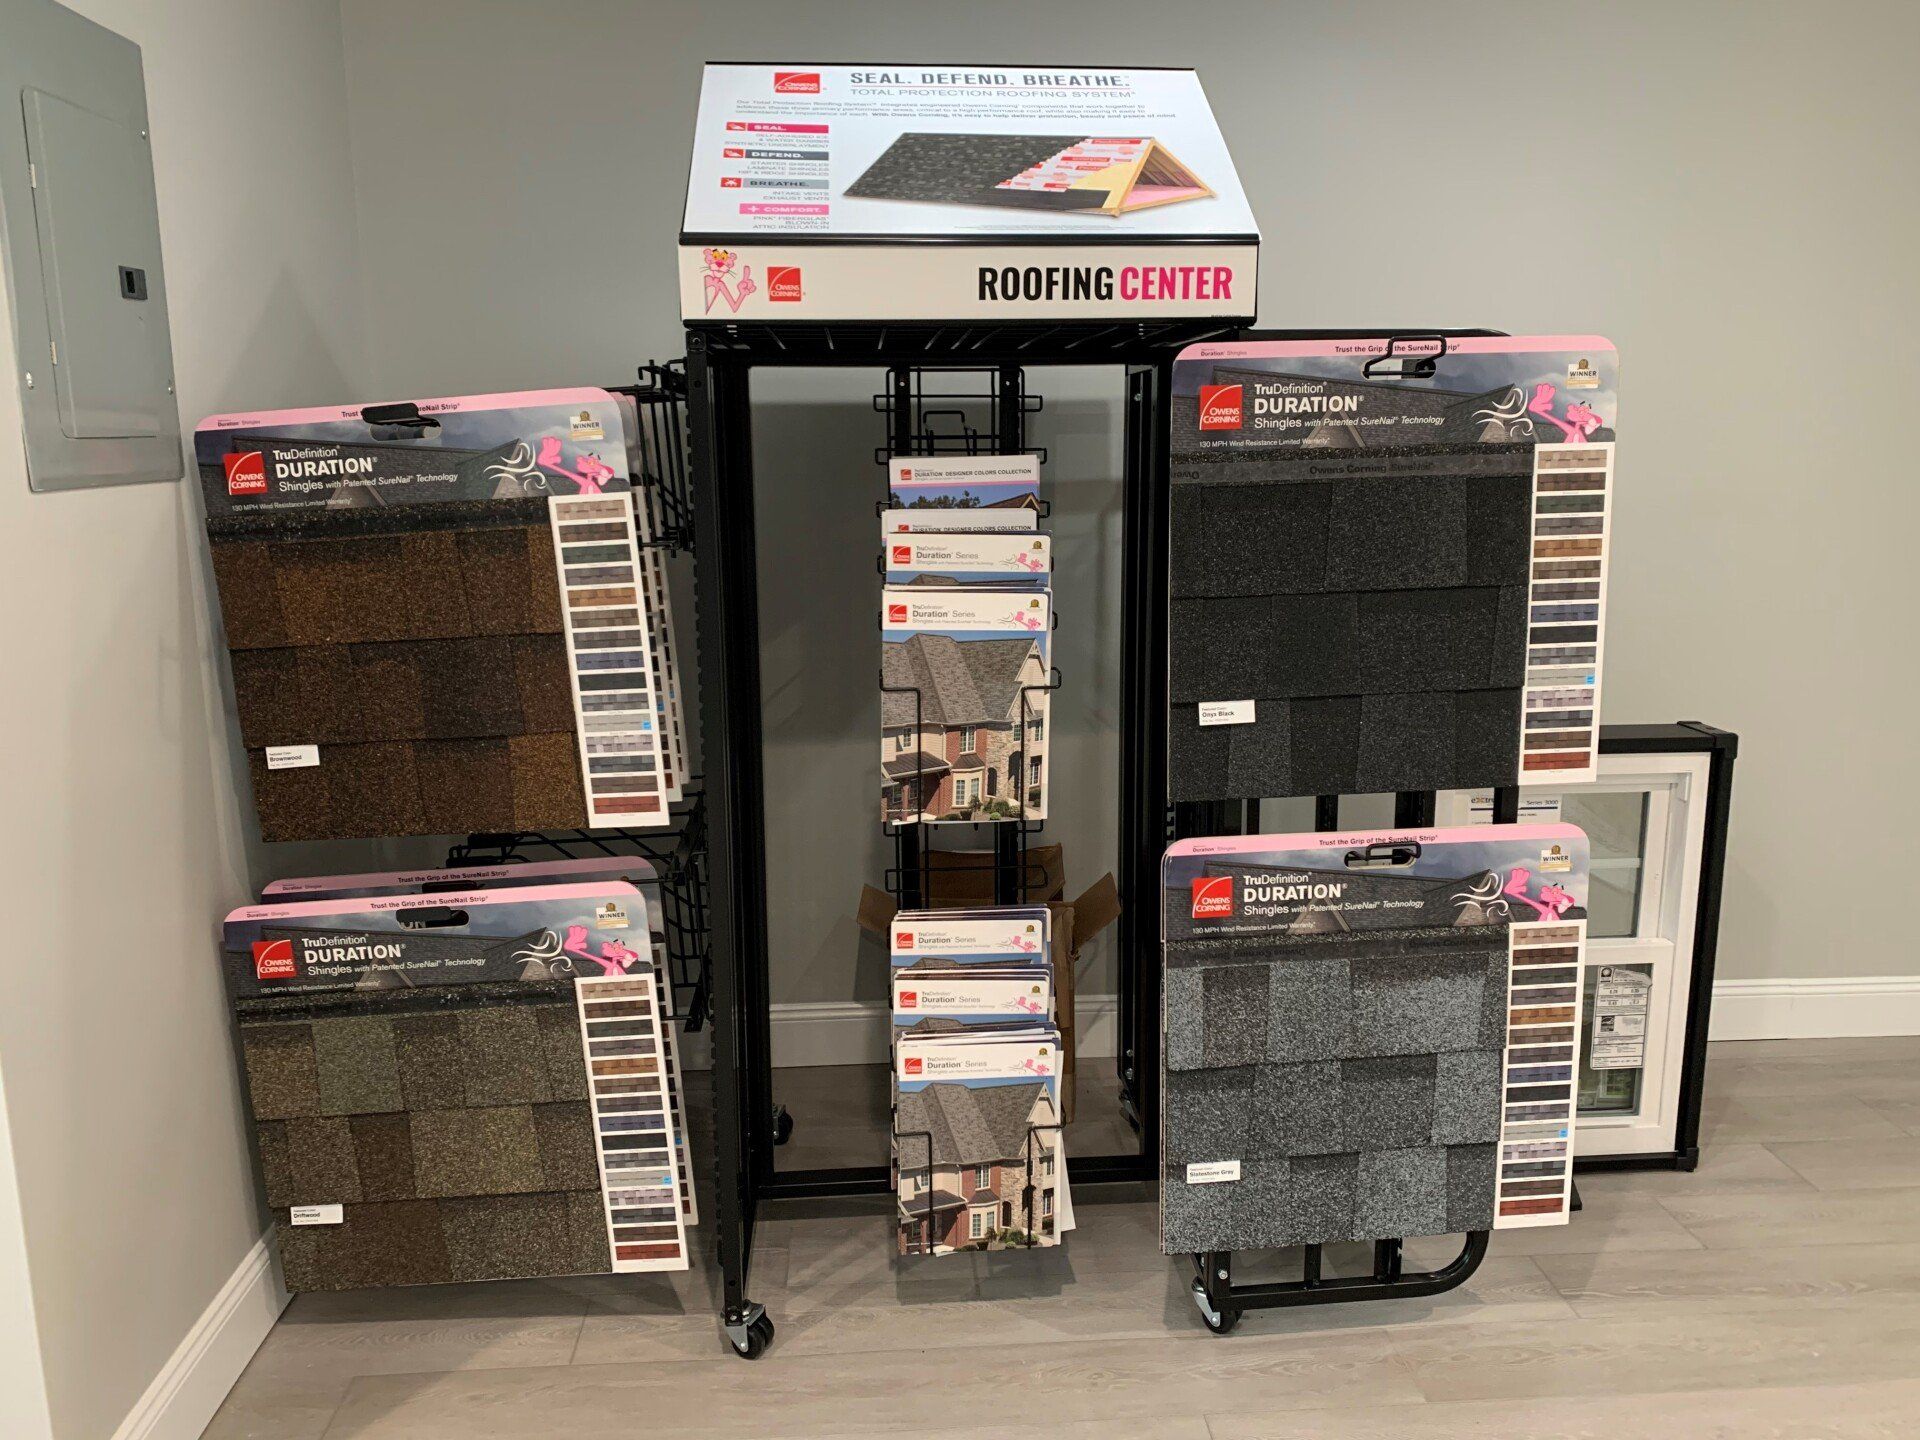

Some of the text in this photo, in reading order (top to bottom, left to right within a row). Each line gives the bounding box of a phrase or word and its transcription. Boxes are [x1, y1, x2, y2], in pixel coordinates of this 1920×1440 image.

[850, 72, 1130, 87] SEAL. DEFEND. BREATHE.
[850, 88, 896, 96] TOTAL
[898, 89, 993, 97] PROTECTION
[996, 90, 1069, 98] ROOFING
[751, 151, 804, 159] DEFEND.
[978, 266, 1233, 301] ROOFING CENTER
[770, 290, 800, 298] CORNING
[1335, 345, 1352, 353] Trust
[1368, 345, 1382, 354] Grip
[1394, 344, 1406, 352] the
[1407, 344, 1438, 352] SureNail
[1254, 382, 1324, 396] TruDefinition
[441, 402, 458, 411] Strip
[1209, 407, 1239, 415] OWENS
[341, 410, 359, 418] Trust
[1203, 414, 1239, 424] CORNING
[572, 421, 600, 430] WINNER
[1254, 416, 1302, 431] Shingles
[1304, 417, 1321, 427] with
[1322, 416, 1358, 427] Patented
[1401, 414, 1445, 427] Technology
[1199, 440, 1211, 448] 130
[1229, 439, 1244, 447] Wind
[1245, 438, 1278, 447] Resistance
[1279, 437, 1301, 446] Limited
[272, 446, 338, 462] TruDefinition
[945, 470, 974, 478] DESIGNER
[974, 469, 997, 477] COLORS
[997, 467, 1032, 476] COLLECTION
[1309, 464, 1387, 475] Owens Corning
[235, 472, 264, 482] OWENS
[278, 480, 324, 494] Shingles
[325, 480, 342, 490] with
[342, 477, 377, 489] Patented
[416, 471, 459, 485] Technology
[231, 479, 266, 490] CORNING
[243, 503, 259, 511] MPH
[259, 501, 273, 510] Wind
[273, 500, 304, 509] Resistance
[304, 499, 325, 508] Limited
[955, 552, 979, 560] Series
[912, 609, 977, 619] Duration Series
[269, 755, 302, 763] Brownwood
[1319, 838, 1336, 846] Trust
[1350, 837, 1365, 846] Grip
[1375, 836, 1387, 844] the
[1419, 835, 1436, 843] Strip
[398, 876, 414, 884] Trust
[427, 874, 441, 883] Grip
[450, 872, 461, 880] the
[462, 870, 490, 880] SureNail
[490, 870, 507, 880] Strip
[1243, 872, 1309, 886] TruDefinition
[370, 895, 486, 910] Trust the Grip of the SureNail Strip
[1201, 896, 1230, 905] OWENS
[1195, 903, 1231, 913] CORNING
[1244, 904, 1289, 918] Shingles
[1290, 904, 1307, 914] with
[1308, 901, 1343, 913] Patented
[1382, 898, 1425, 912] Technology
[598, 911, 626, 920] WINNER
[1192, 926, 1204, 935] 130
[1204, 926, 1220, 934] MPH
[1220, 924, 1235, 933] Wind
[1235, 923, 1266, 932] Resistance
[1266, 922, 1287, 931] Limited
[301, 934, 368, 950] TruDefinition
[918, 936, 977, 945] Duration Series
[264, 957, 293, 968] OWENS
[307, 965, 353, 980] Shingles
[354, 964, 371, 975] with
[371, 961, 406, 974] Patented
[444, 956, 487, 971] Technology
[259, 964, 295, 976] CORNING
[260, 986, 271, 994] 130
[271, 985, 287, 993] MPH
[302, 982, 333, 991] Resistance
[333, 981, 355, 990] Limited
[958, 995, 982, 1004] Series
[927, 1060, 988, 1070] Duration Series
